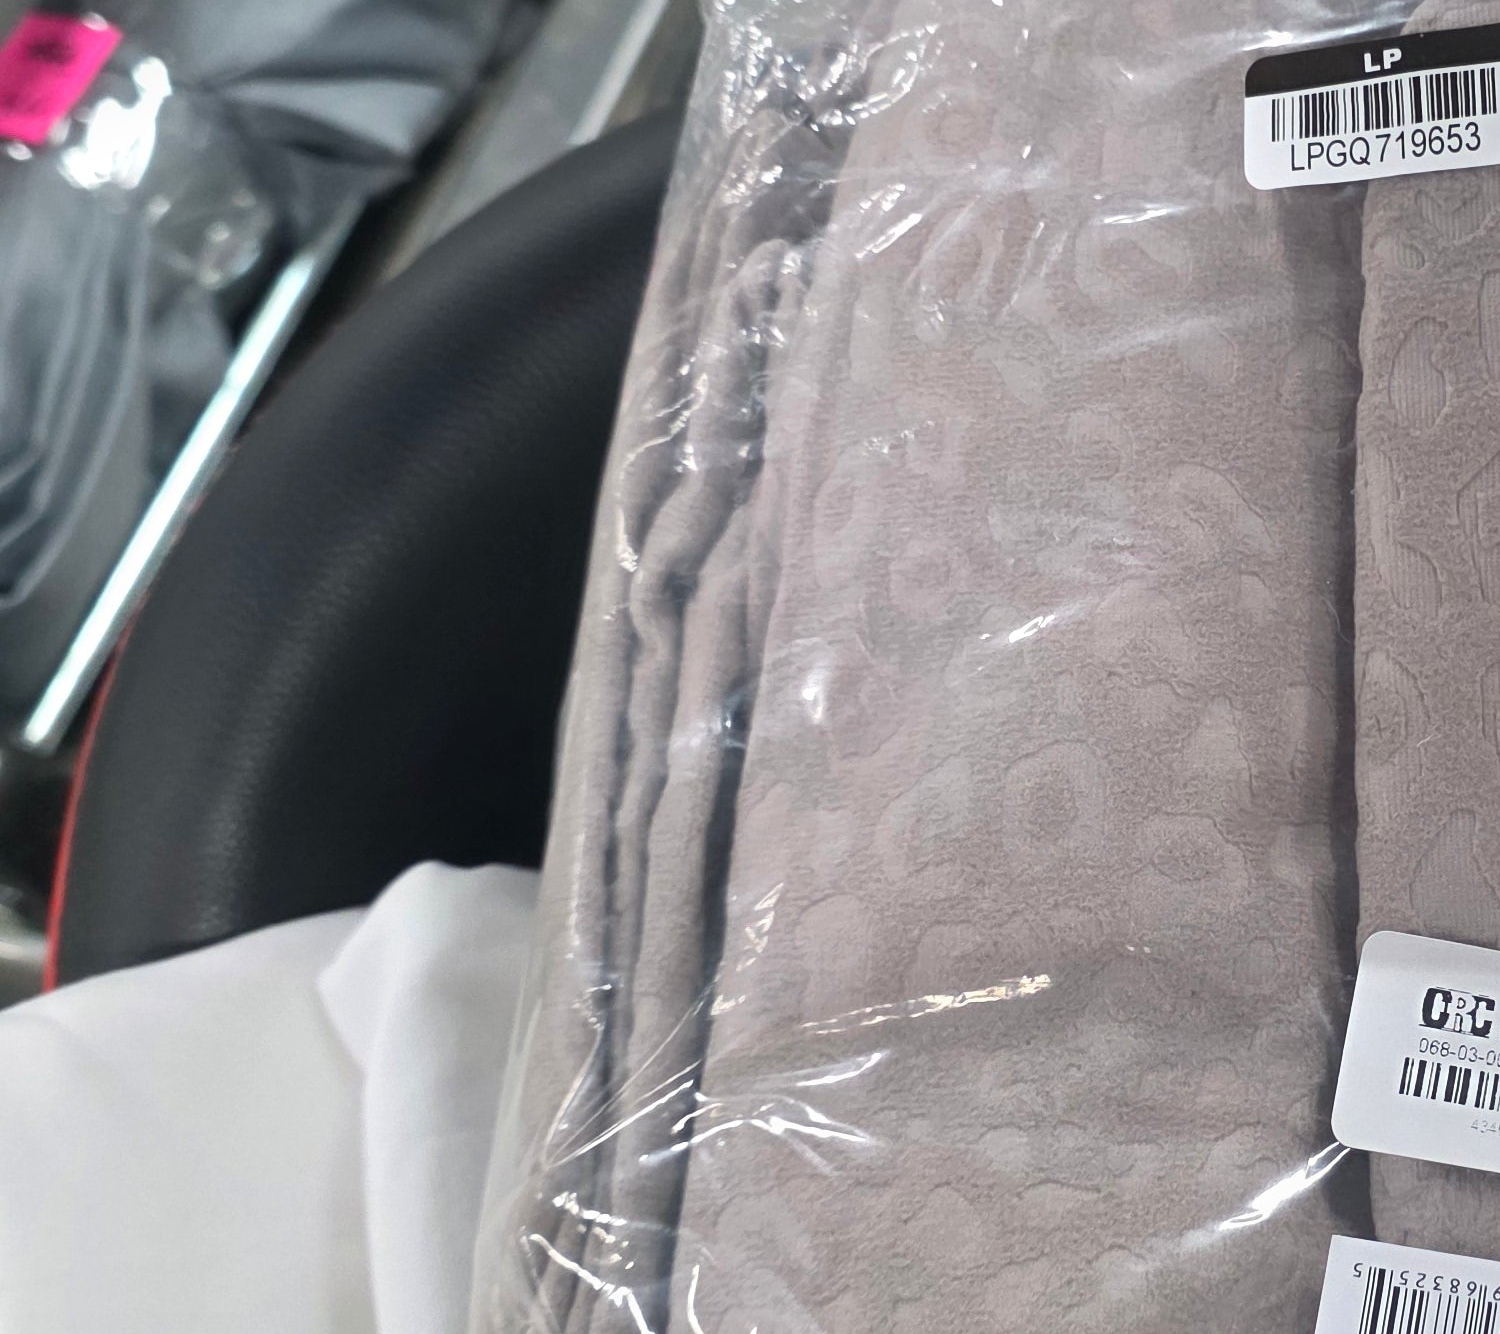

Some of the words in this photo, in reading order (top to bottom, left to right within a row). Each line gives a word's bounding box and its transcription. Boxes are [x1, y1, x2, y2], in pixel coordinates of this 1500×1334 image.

[1363, 48, 1403, 73] LP
[1291, 121, 1482, 172] LPGQ719653
[1352, 1262, 1364, 1278] 5
[1399, 1269, 1477, 1297] 68325
